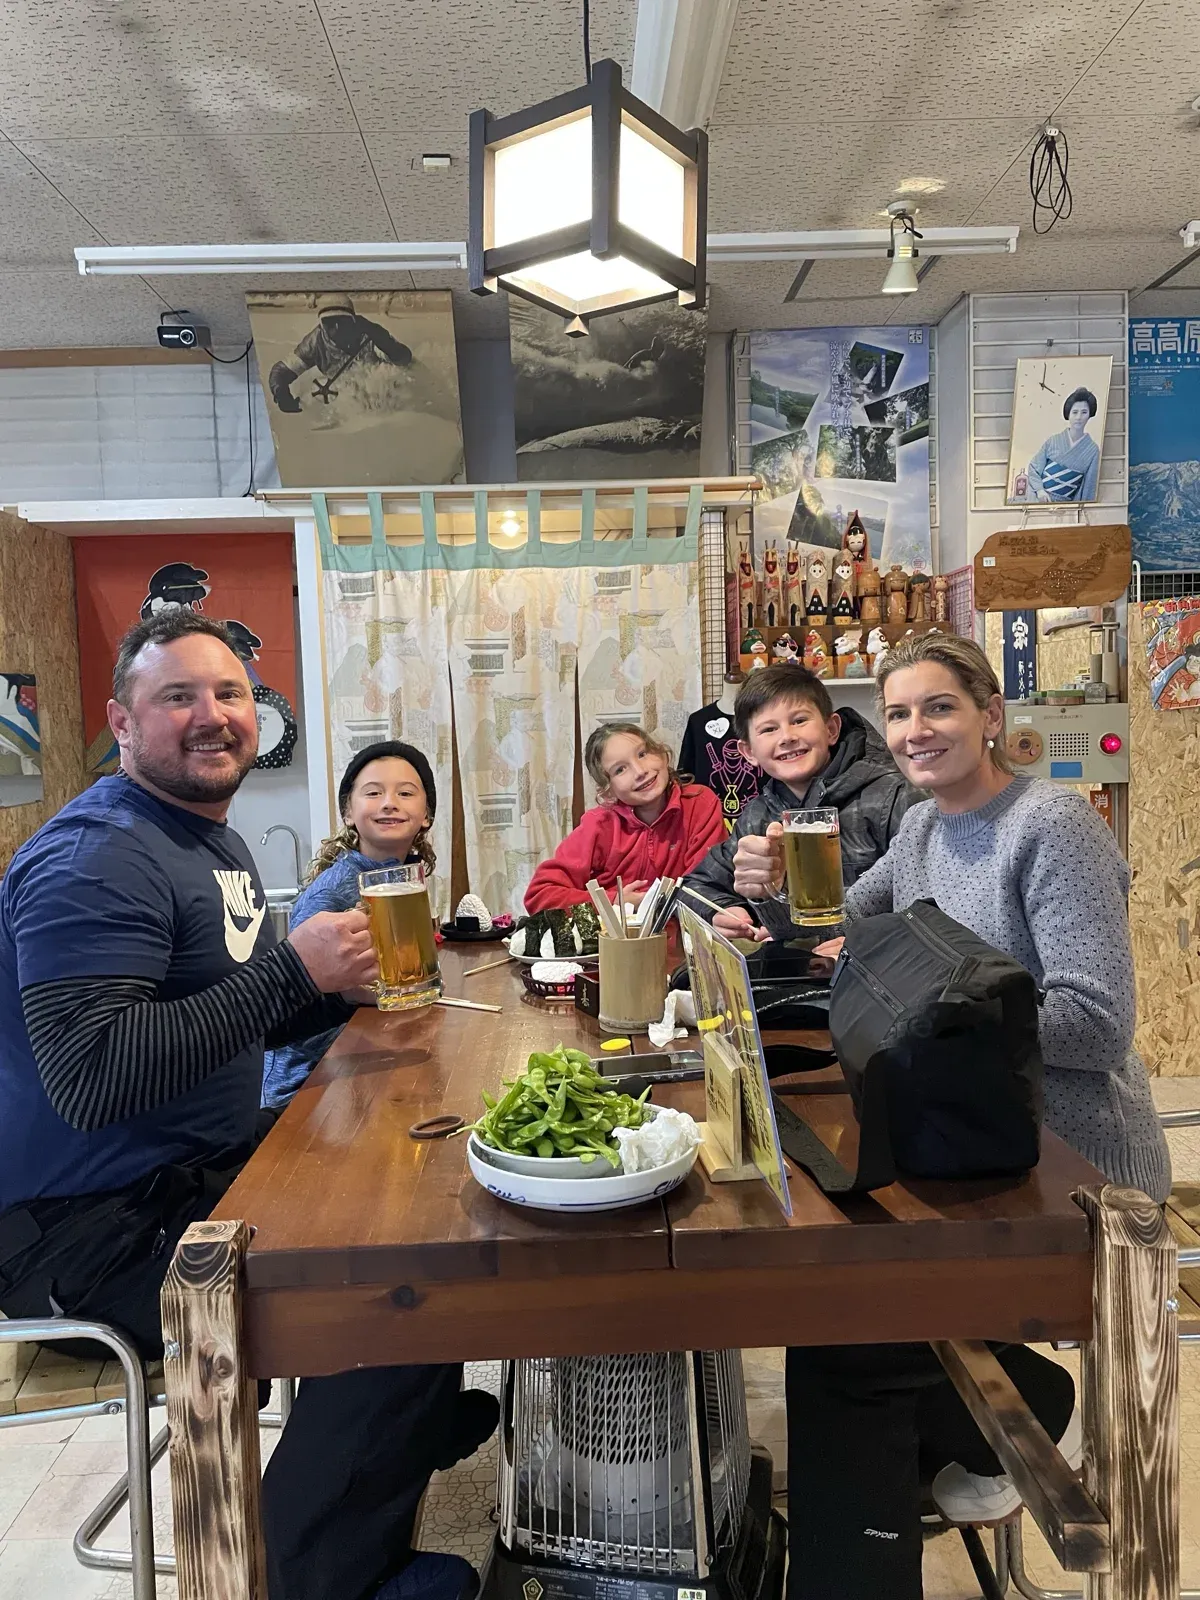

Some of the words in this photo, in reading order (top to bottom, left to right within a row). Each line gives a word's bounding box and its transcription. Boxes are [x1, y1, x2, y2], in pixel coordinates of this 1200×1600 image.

[1128, 321, 1200, 355] 高高原
[727, 800, 737, 810] 酒
[212, 869, 256, 918] NIKE
[863, 1528, 899, 1540] SPYDER
